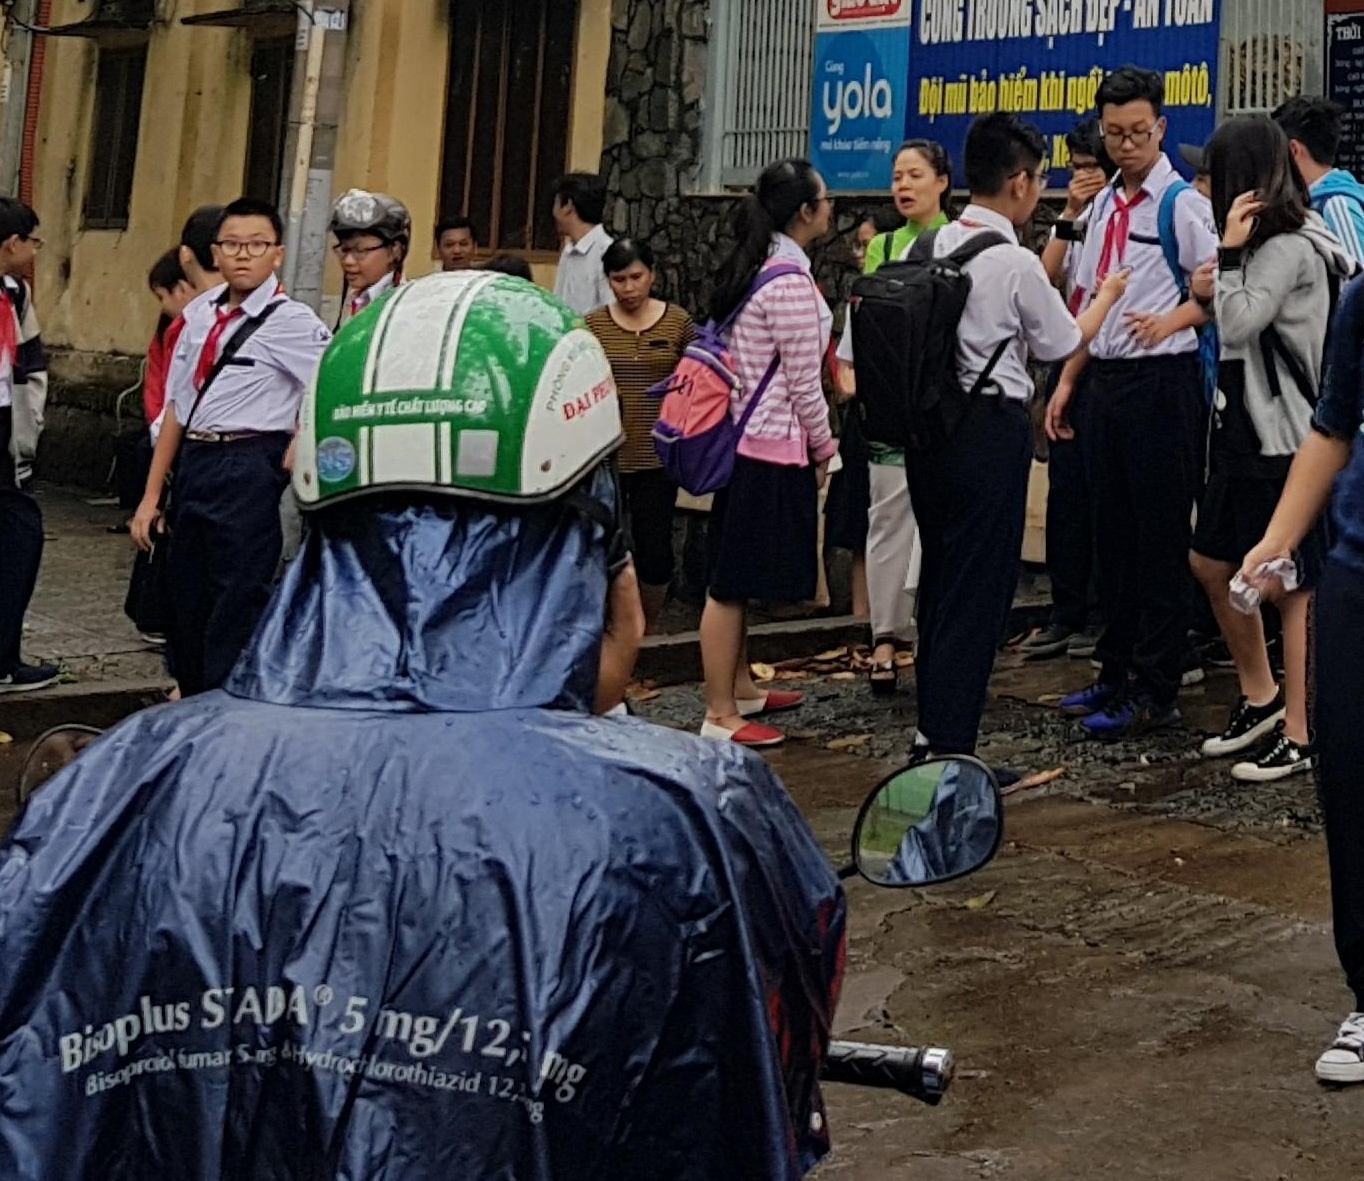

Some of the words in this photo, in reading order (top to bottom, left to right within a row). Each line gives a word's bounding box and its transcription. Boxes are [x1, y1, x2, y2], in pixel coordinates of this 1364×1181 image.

[1335, 21, 1362, 40] THỜI
[823, 62, 893, 136] yola
[918, 75, 944, 124] Đội
[945, 74, 968, 115] mũ
[969, 68, 998, 114] bảo
[999, 66, 1039, 113] hiểm
[1039, 69, 1066, 111] khi
[59, 993, 192, 1074] Bisoplus
[338, 994, 370, 1035] 5
[541, 1050, 588, 1103] mg
